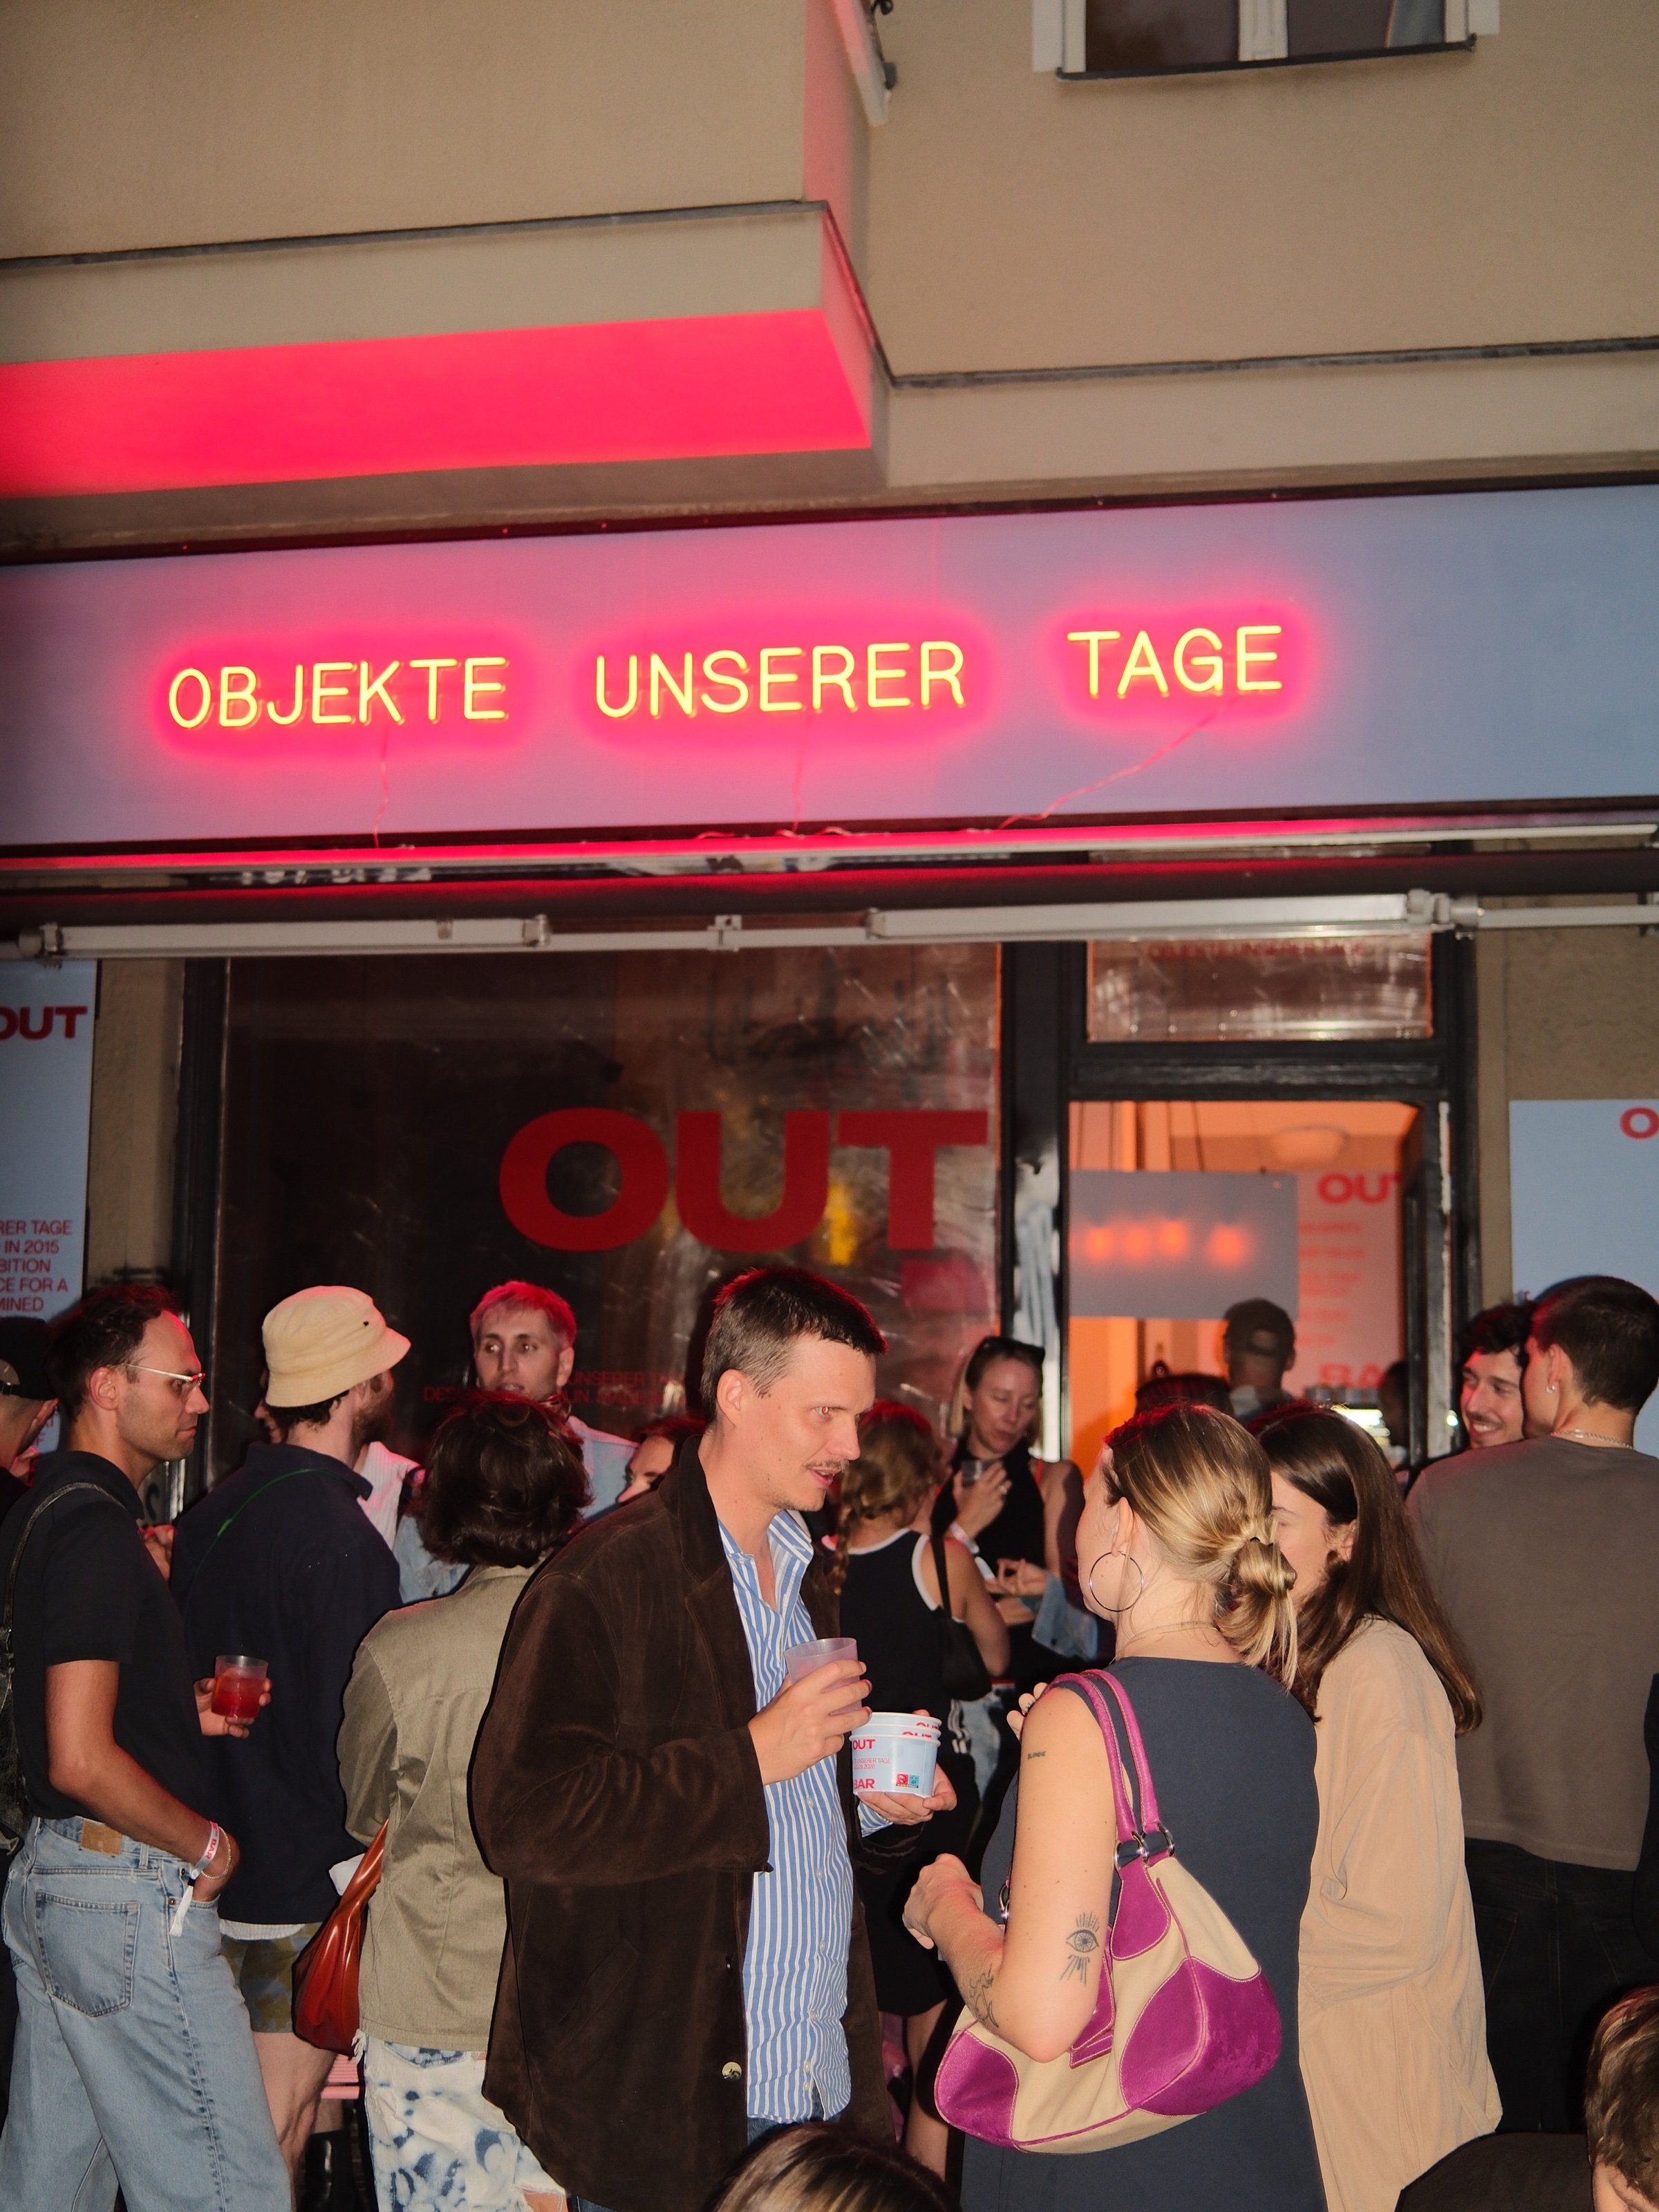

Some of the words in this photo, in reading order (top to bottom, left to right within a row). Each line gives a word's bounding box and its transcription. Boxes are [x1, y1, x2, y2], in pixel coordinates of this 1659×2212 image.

[168, 656, 509, 729] OBJEKTE
[595, 640, 966, 718] UNSERER
[1067, 625, 1283, 698] TAGE
[499, 1107, 989, 1253] OUT
[31, 1219, 73, 1235] TAGE
[5, 1239, 20, 1254] IN
[24, 1239, 59, 1255] 2015
[20, 1277, 53, 1293] FOR
[57, 1277, 68, 1292] A
[852, 1738, 876, 1750] OUT
[854, 1778, 875, 1790] BAR
[205, 1839, 216, 1859] BAR
